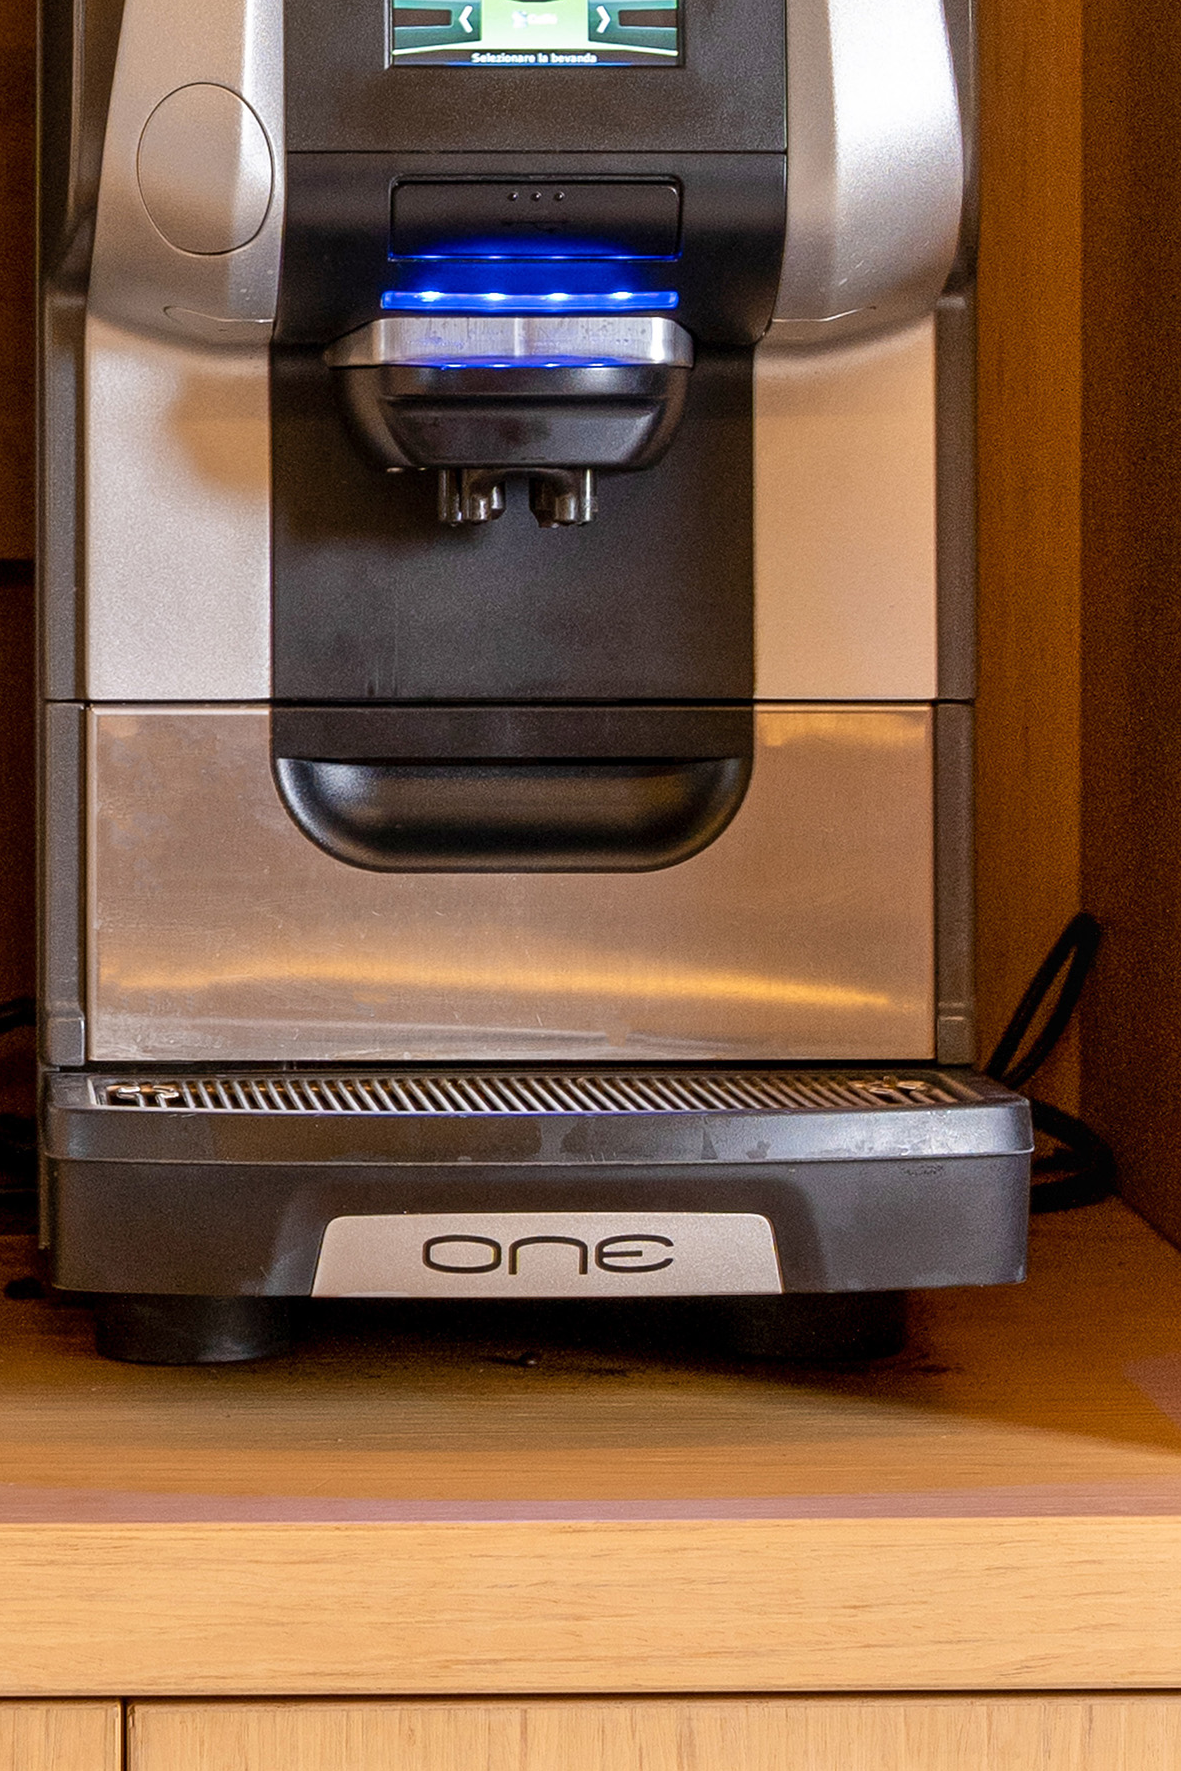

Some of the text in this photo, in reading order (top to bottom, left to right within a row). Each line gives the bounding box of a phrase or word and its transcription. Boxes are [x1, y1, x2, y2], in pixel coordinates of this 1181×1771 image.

[471, 52, 597, 64] Selezionare la bevanda
